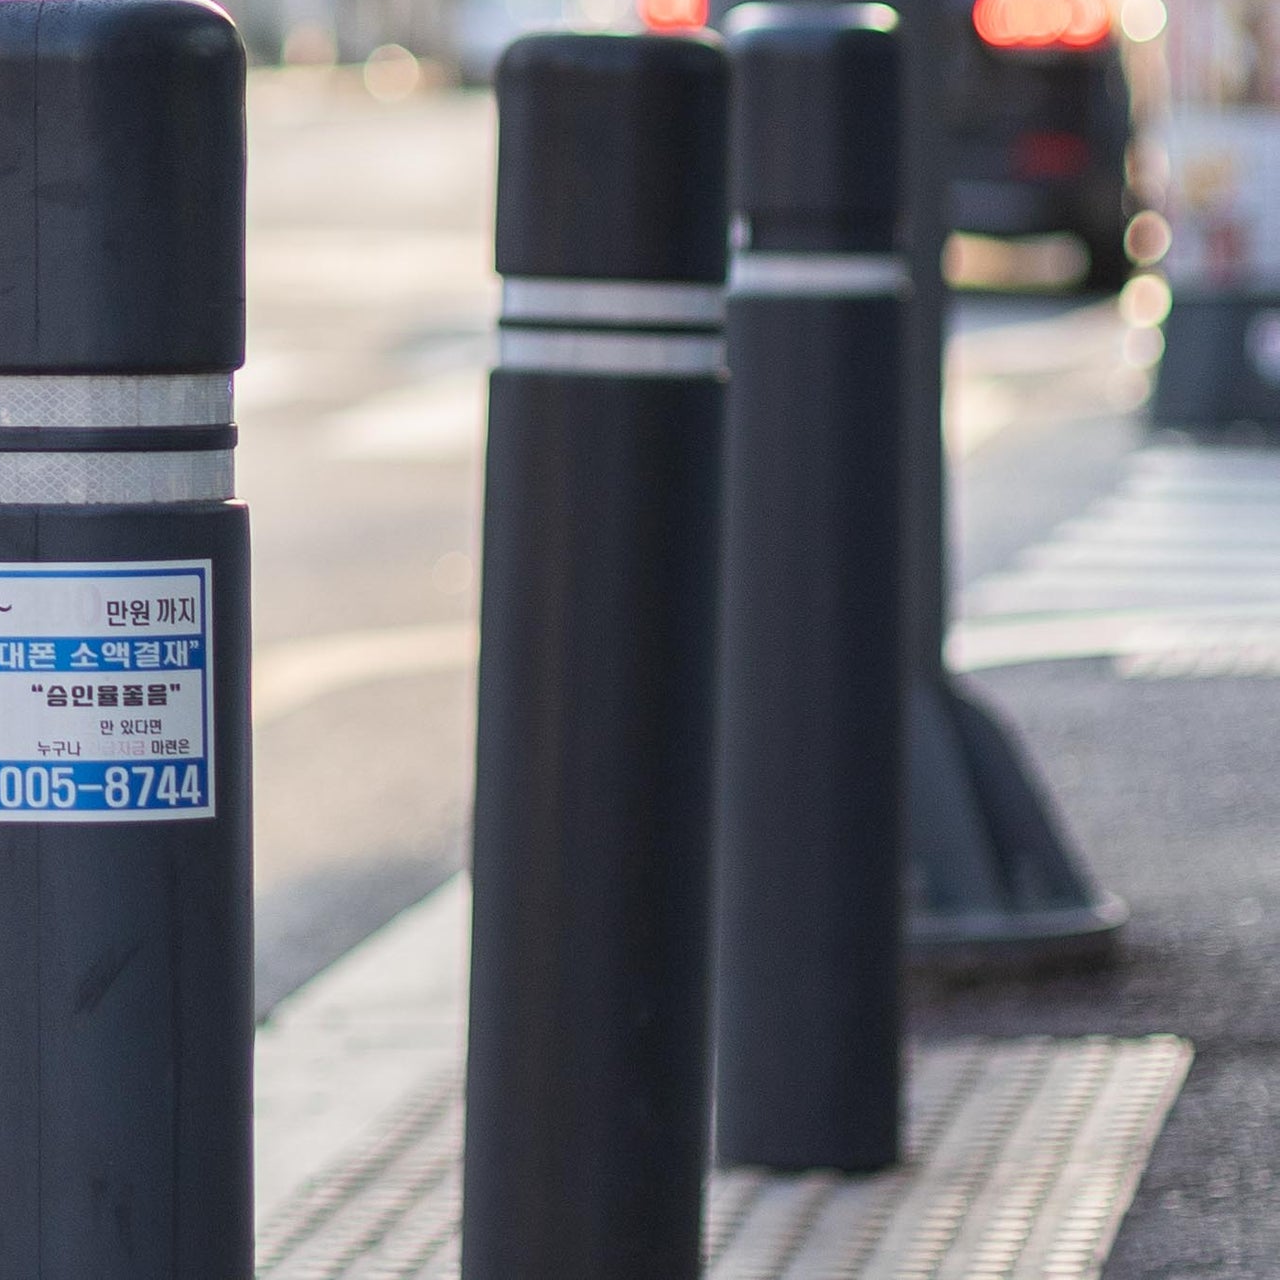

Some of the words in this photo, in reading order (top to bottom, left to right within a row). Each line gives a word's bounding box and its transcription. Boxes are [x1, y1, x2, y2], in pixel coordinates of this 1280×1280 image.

[107, 600, 150, 627] 만원
[156, 597, 195, 625] 까지
[100, 719, 113, 735] 만
[120, 718, 162, 735] 있다면
[37, 741, 81, 757] 누구나
[151, 738, 190, 755] 마련은
